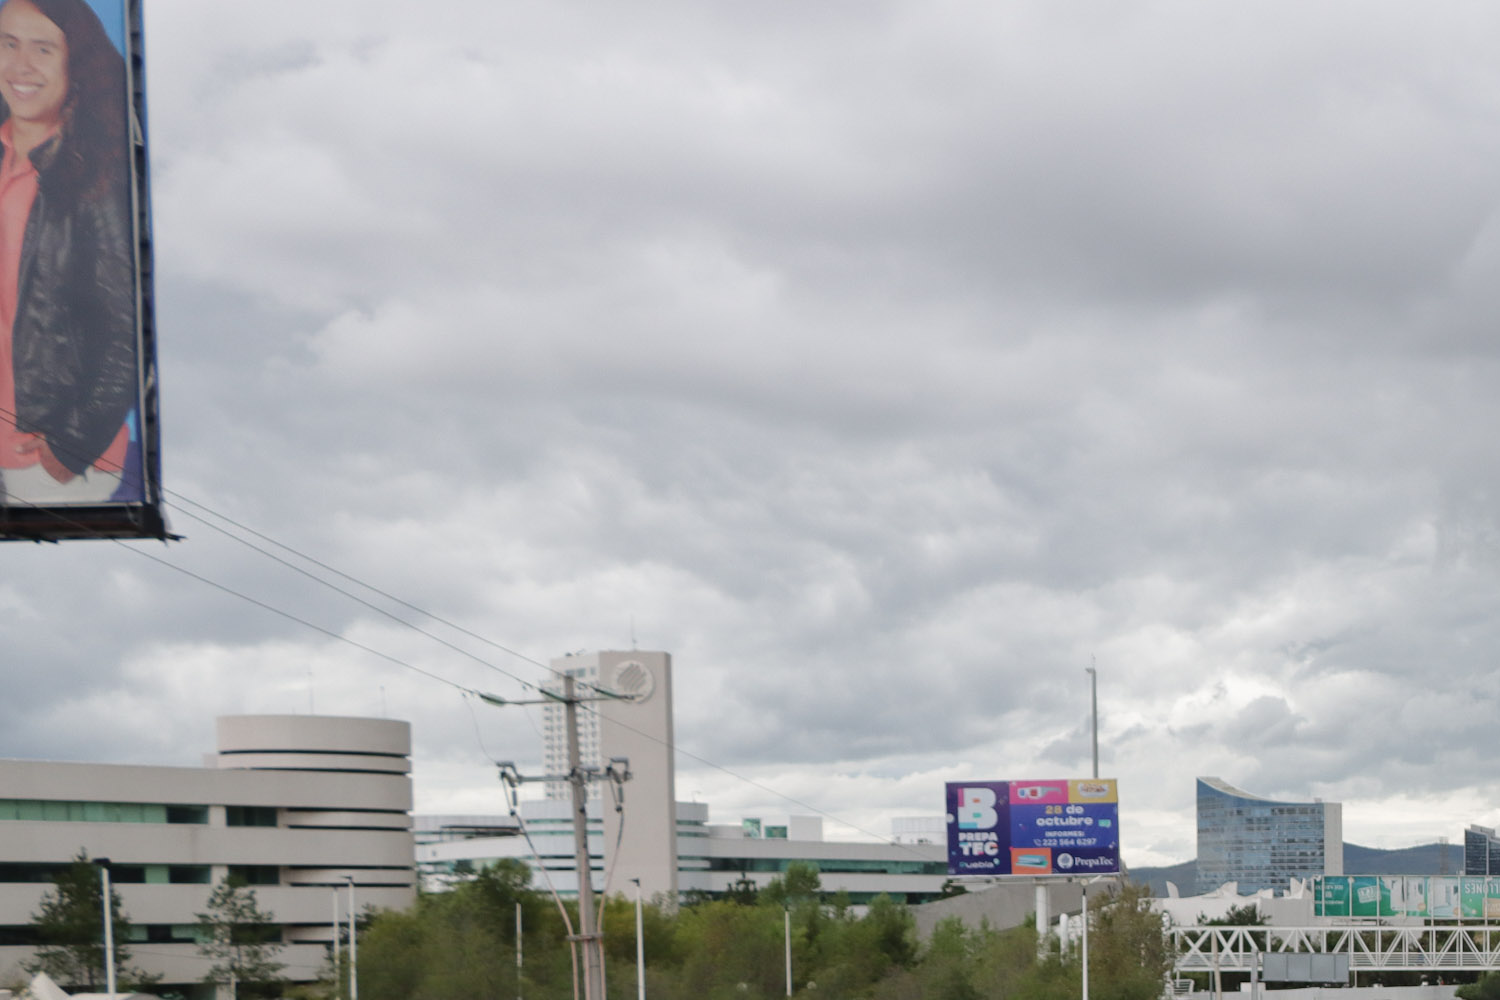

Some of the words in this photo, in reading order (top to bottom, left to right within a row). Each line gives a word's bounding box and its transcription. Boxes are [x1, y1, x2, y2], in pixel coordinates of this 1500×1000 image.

[1045, 804, 1063, 815] 28
[1066, 804, 1084, 815] de
[1036, 816, 1093, 827] octubre
[958, 832, 998, 842] PREPA
[1042, 838, 1057, 846] 222
[1074, 855, 1114, 867] PrepaTec
